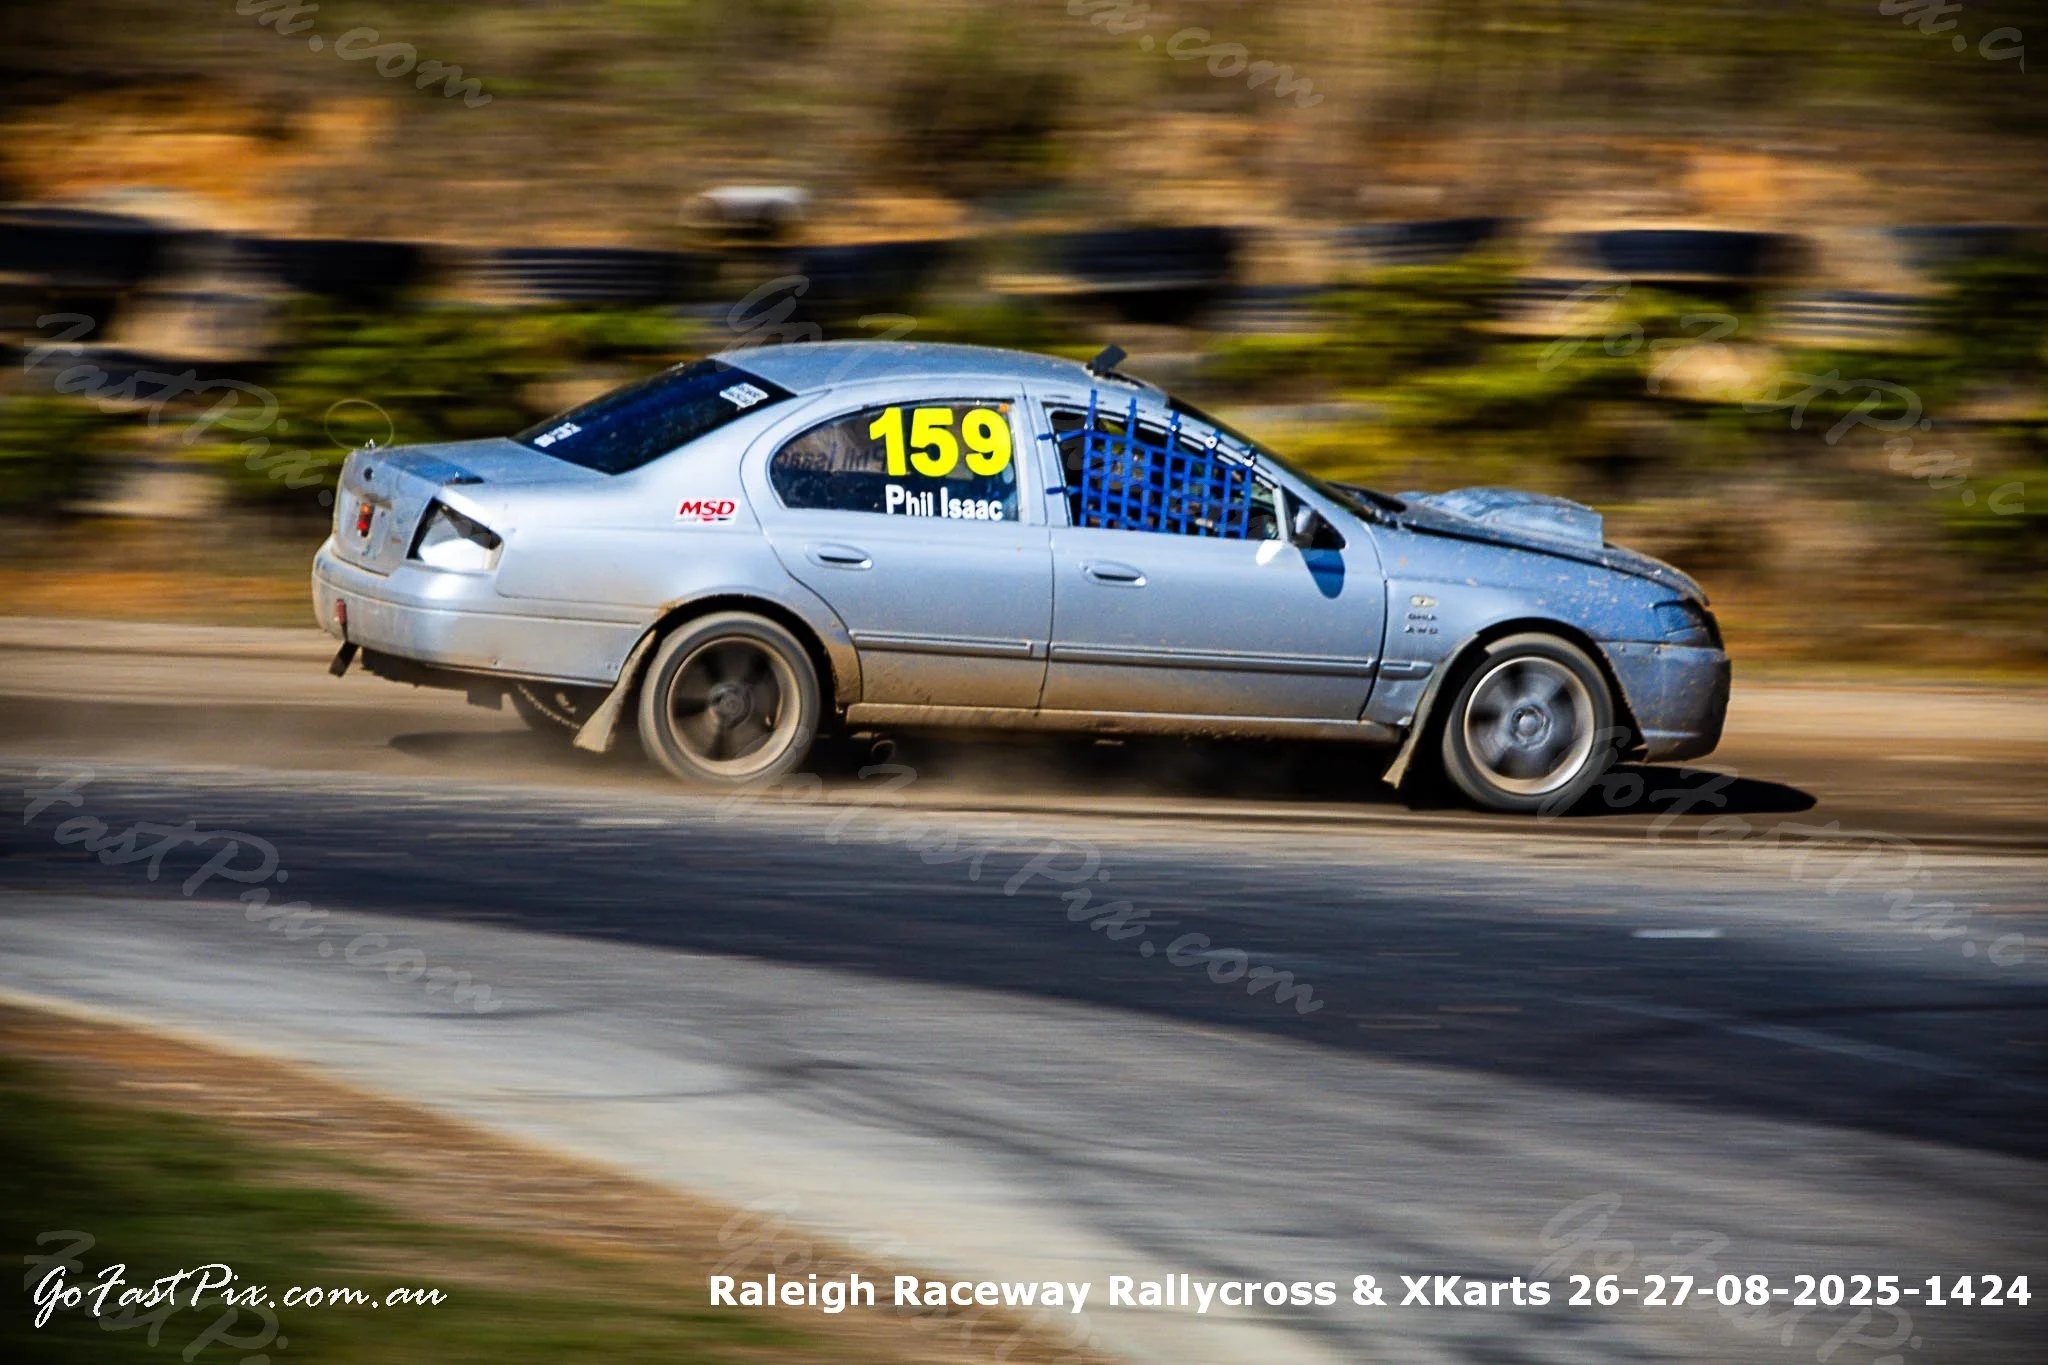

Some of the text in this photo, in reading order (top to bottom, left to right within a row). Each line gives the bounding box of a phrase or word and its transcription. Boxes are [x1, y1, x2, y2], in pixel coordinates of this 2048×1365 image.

[869, 406, 1012, 477] 159
[679, 500, 735, 516] MSD
[885, 484, 1003, 521] Phil Isaac
